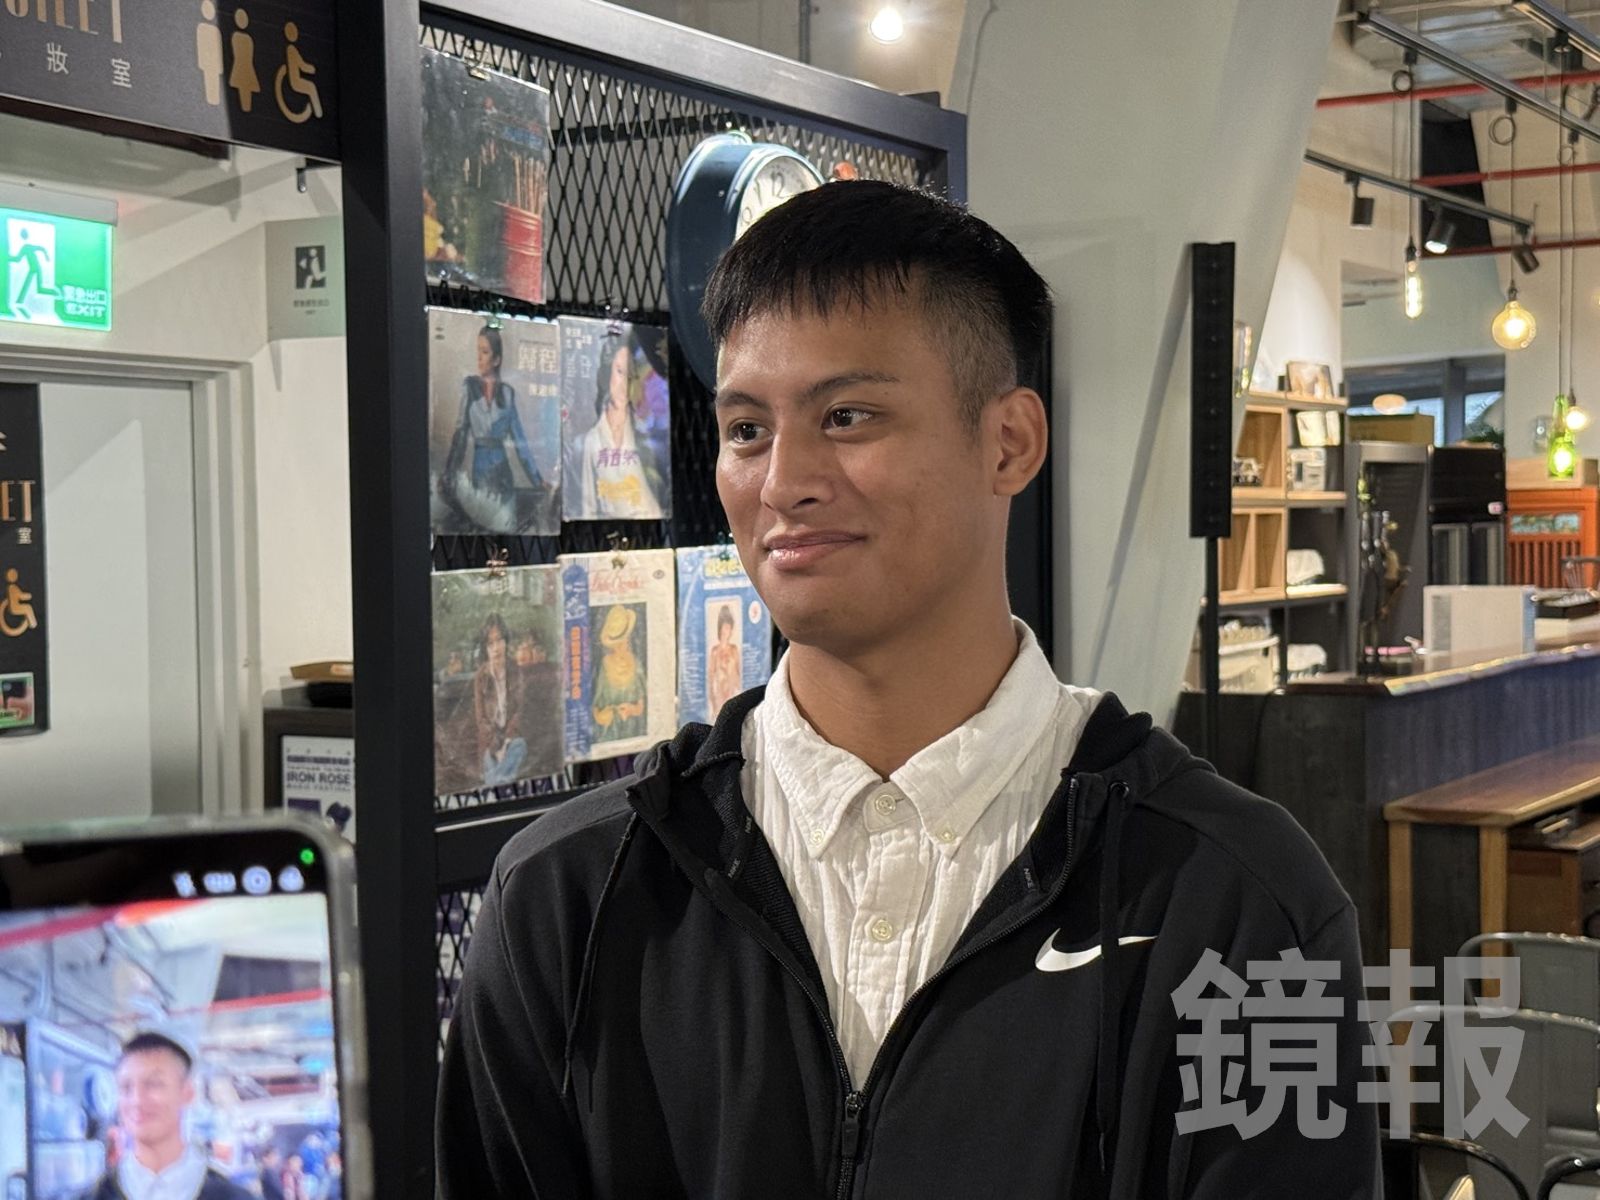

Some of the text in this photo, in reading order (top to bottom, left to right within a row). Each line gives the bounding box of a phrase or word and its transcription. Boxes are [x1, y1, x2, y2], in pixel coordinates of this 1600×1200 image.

[65, 302, 106, 318] EXIT
[287, 770, 351, 786] IRON ROSE
